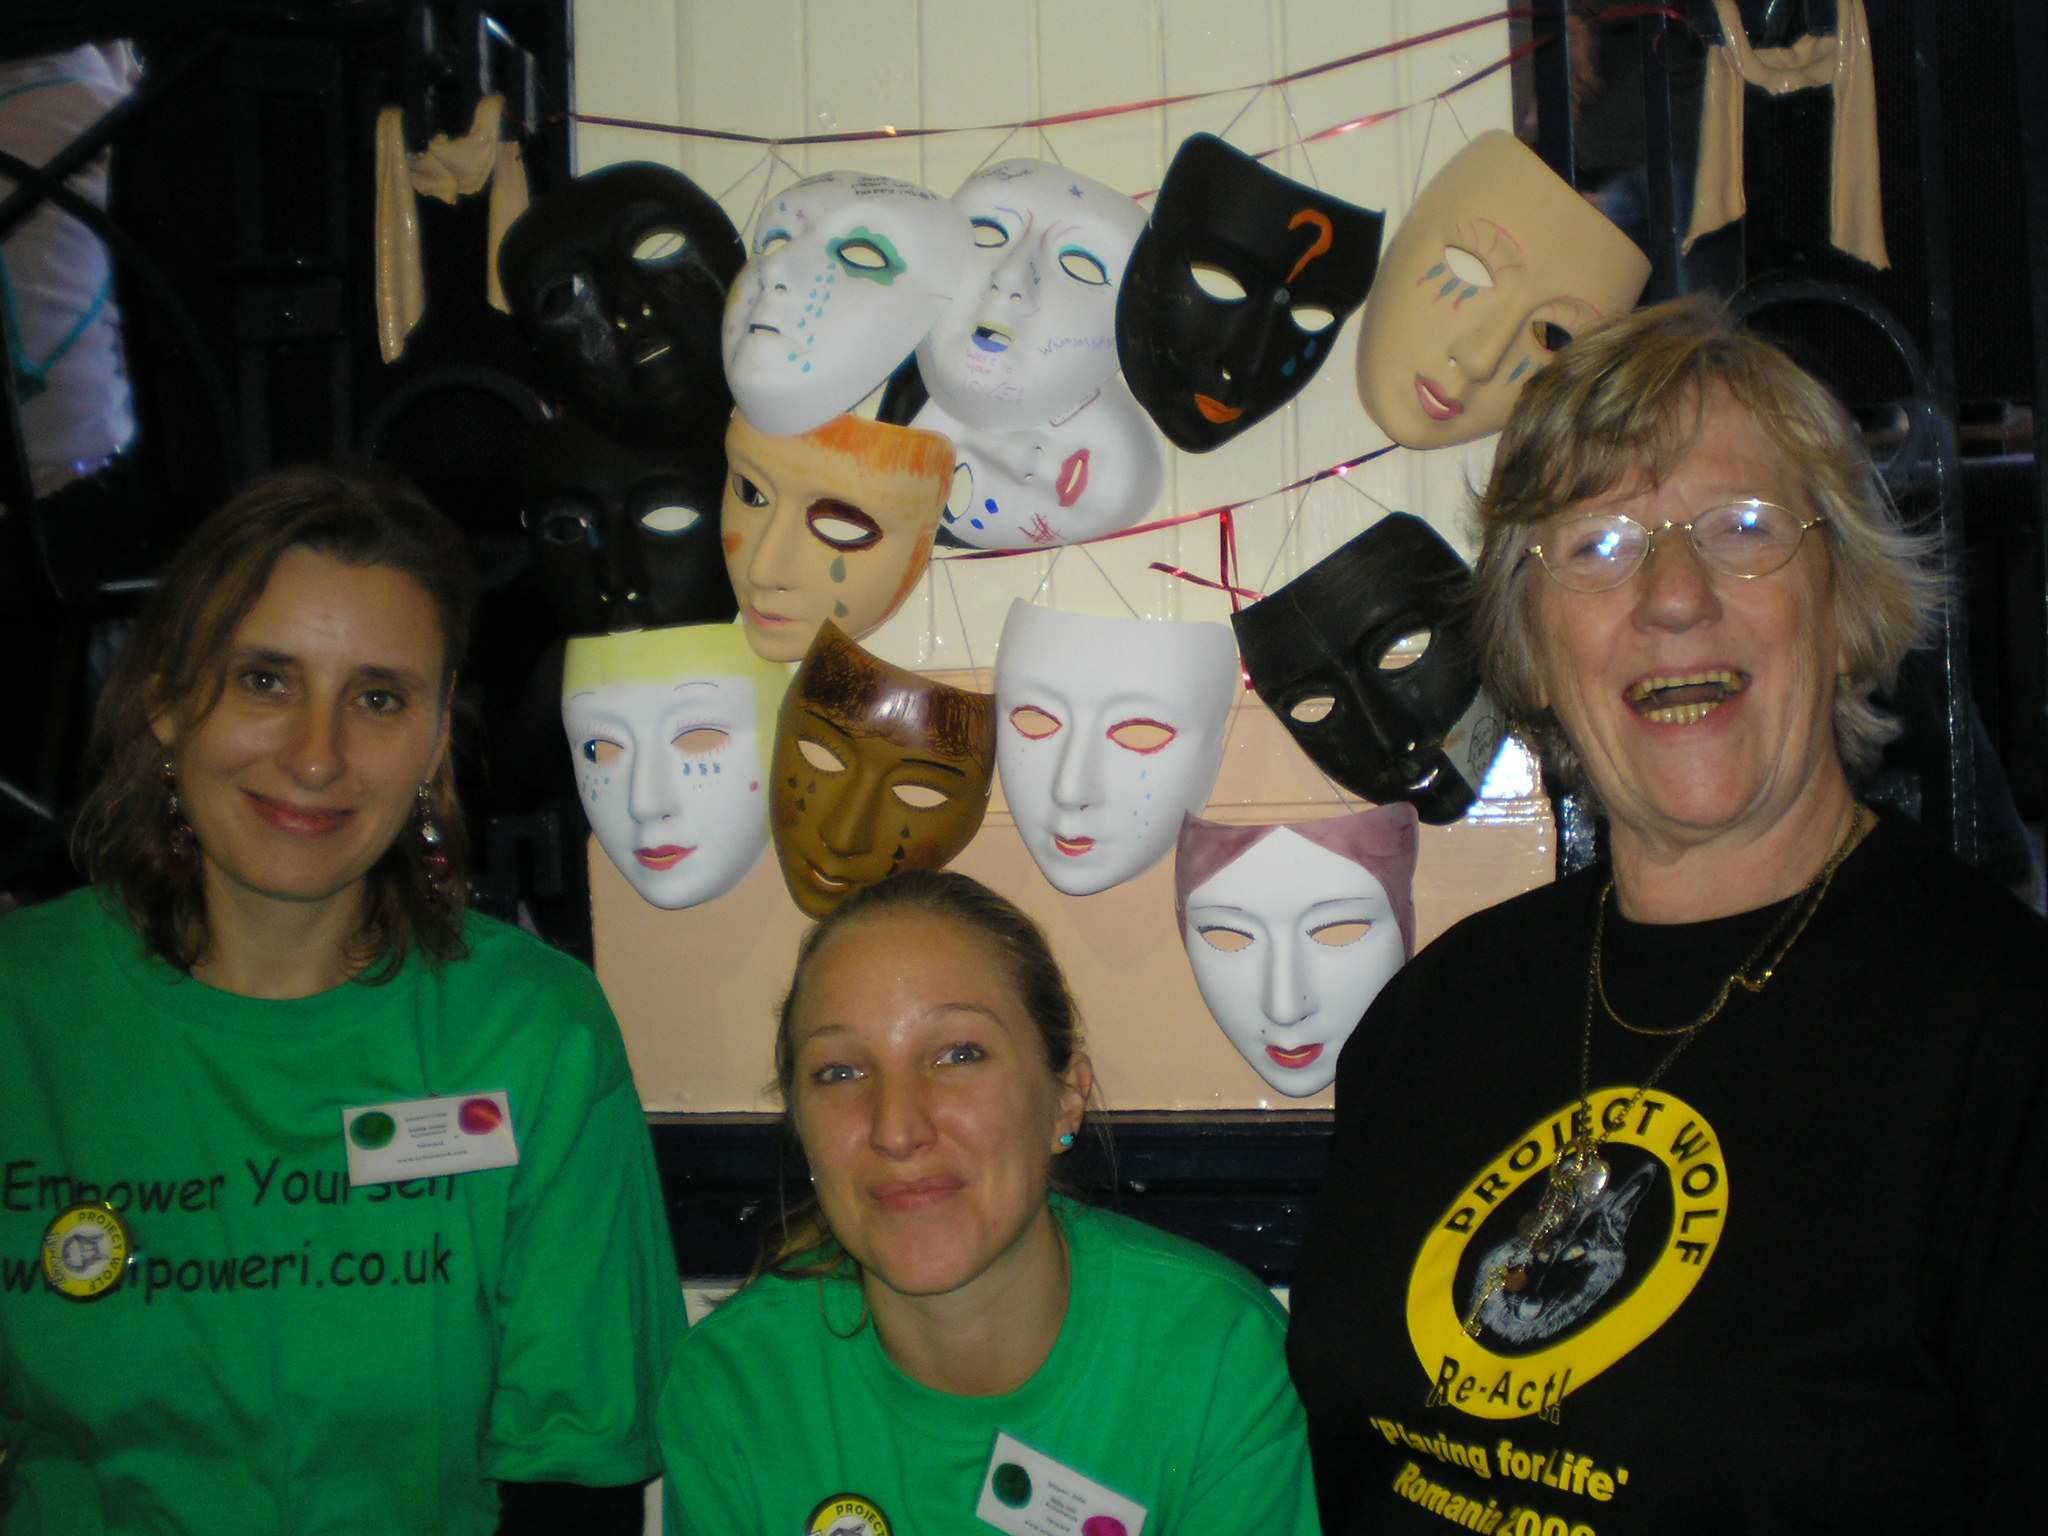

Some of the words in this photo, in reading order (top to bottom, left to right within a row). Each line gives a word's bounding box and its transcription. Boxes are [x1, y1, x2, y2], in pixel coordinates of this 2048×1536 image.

[1444, 1097, 1665, 1235] PROJECT
[1670, 1120, 1720, 1267] WOLF
[78, 1211, 122, 1250] PROJECT
[3, 1232, 453, 1306] wipoweri.co.uk
[88, 1257, 122, 1292] WOLF
[1425, 1355, 1572, 1425] Re-Act!
[1393, 1461, 1503, 1536] Romania
[1496, 1506, 1597, 1536] 200
